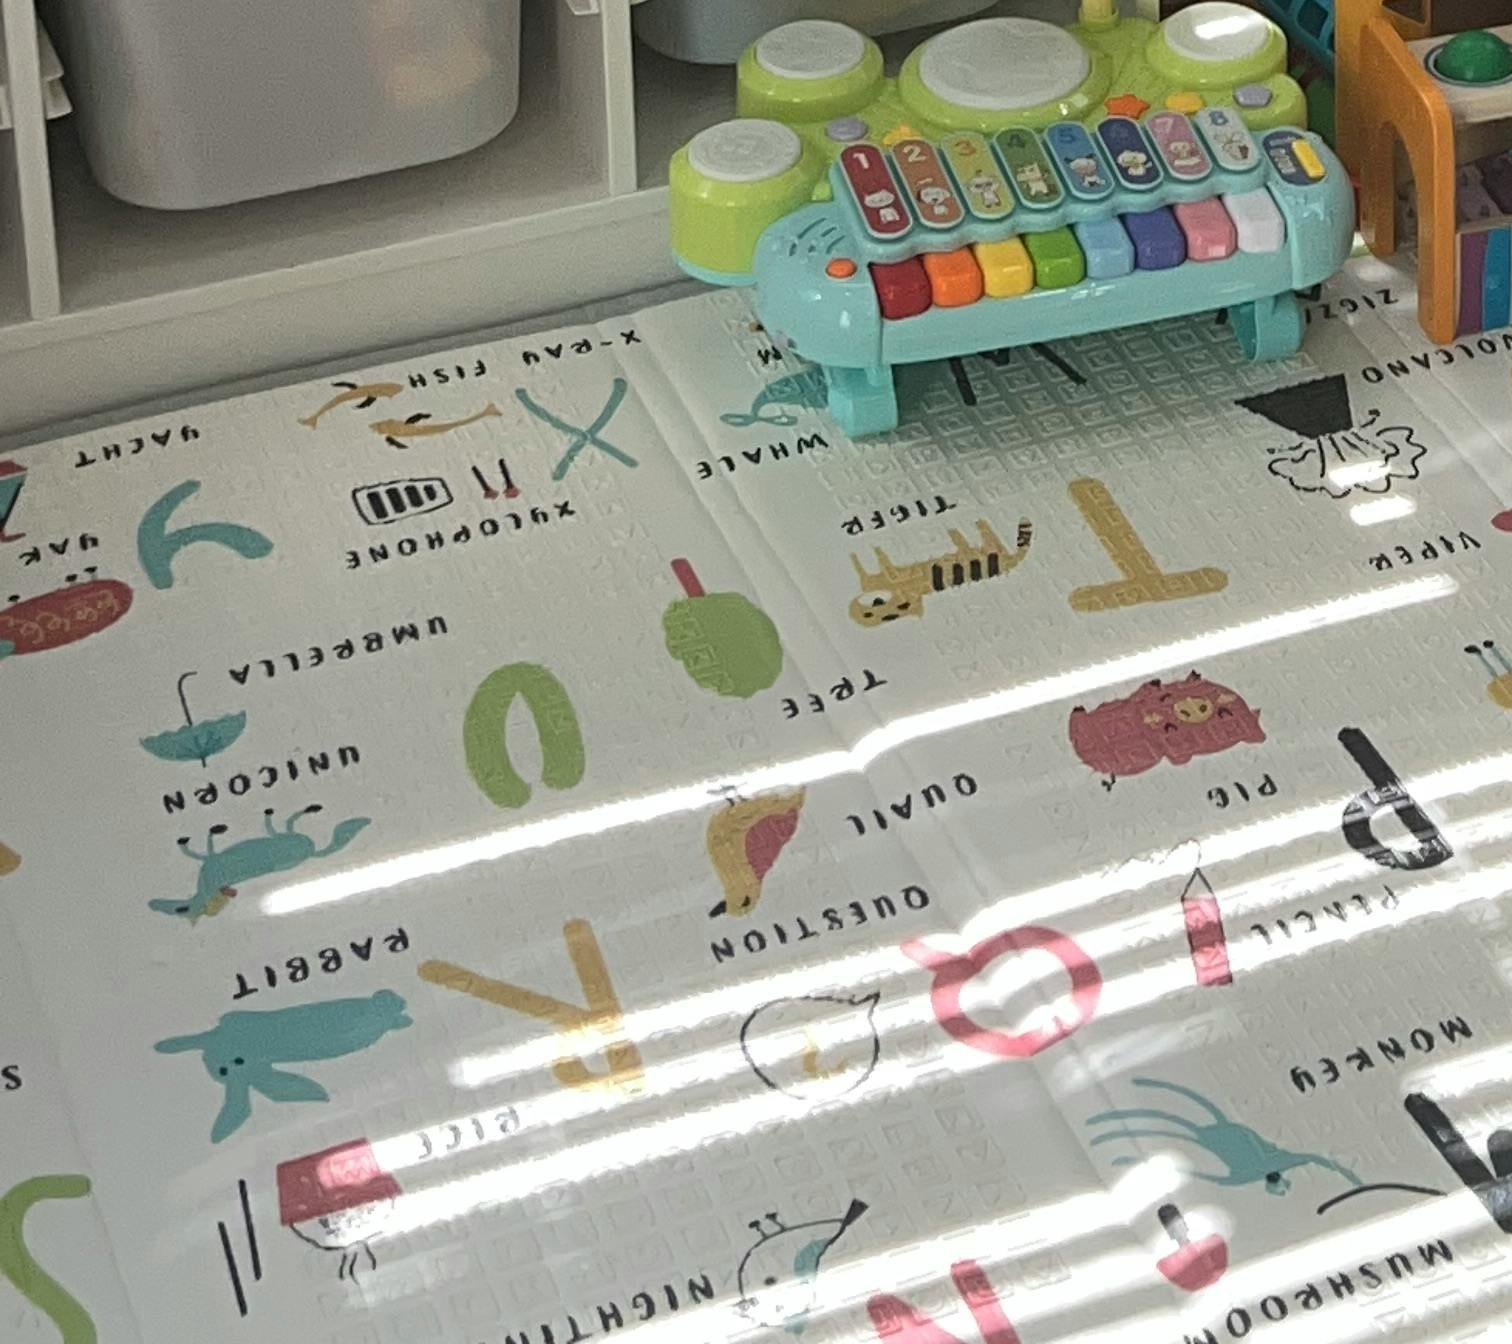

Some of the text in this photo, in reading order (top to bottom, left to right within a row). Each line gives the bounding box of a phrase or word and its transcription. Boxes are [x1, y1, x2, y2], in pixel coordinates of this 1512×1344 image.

[1058, 127, 1077, 145] 5
[1154, 116, 1175, 136] 7
[1208, 110, 1229, 127] 8
[852, 151, 873, 171] 1
[902, 144, 927, 163] 2
[954, 139, 977, 158] 3
[409, 328, 642, 388] X-RAY FISH
[74, 424, 199, 470] YACHT
[514, 377, 640, 481] X
[694, 432, 829, 481] WHALE
[345, 499, 576, 570] XYLOPHONE
[841, 493, 957, 537] TIGER
[18, 532, 99, 567] YAK
[1067, 477, 1230, 613] T
[1368, 529, 1482, 573] VIPER
[228, 615, 448, 685] UMBRELLA
[783, 668, 889, 719] TREE
[462, 661, 587, 810] U
[163, 744, 361, 814] UNICORN
[1206, 772, 1278, 809] PIG
[846, 772, 978, 838] QUAIL
[709, 884, 931, 964] QUESTION
[1250, 883, 1401, 946] PENCIL
[231, 927, 410, 1001] RABBIT
[1290, 1014, 1474, 1094] MONKEY
